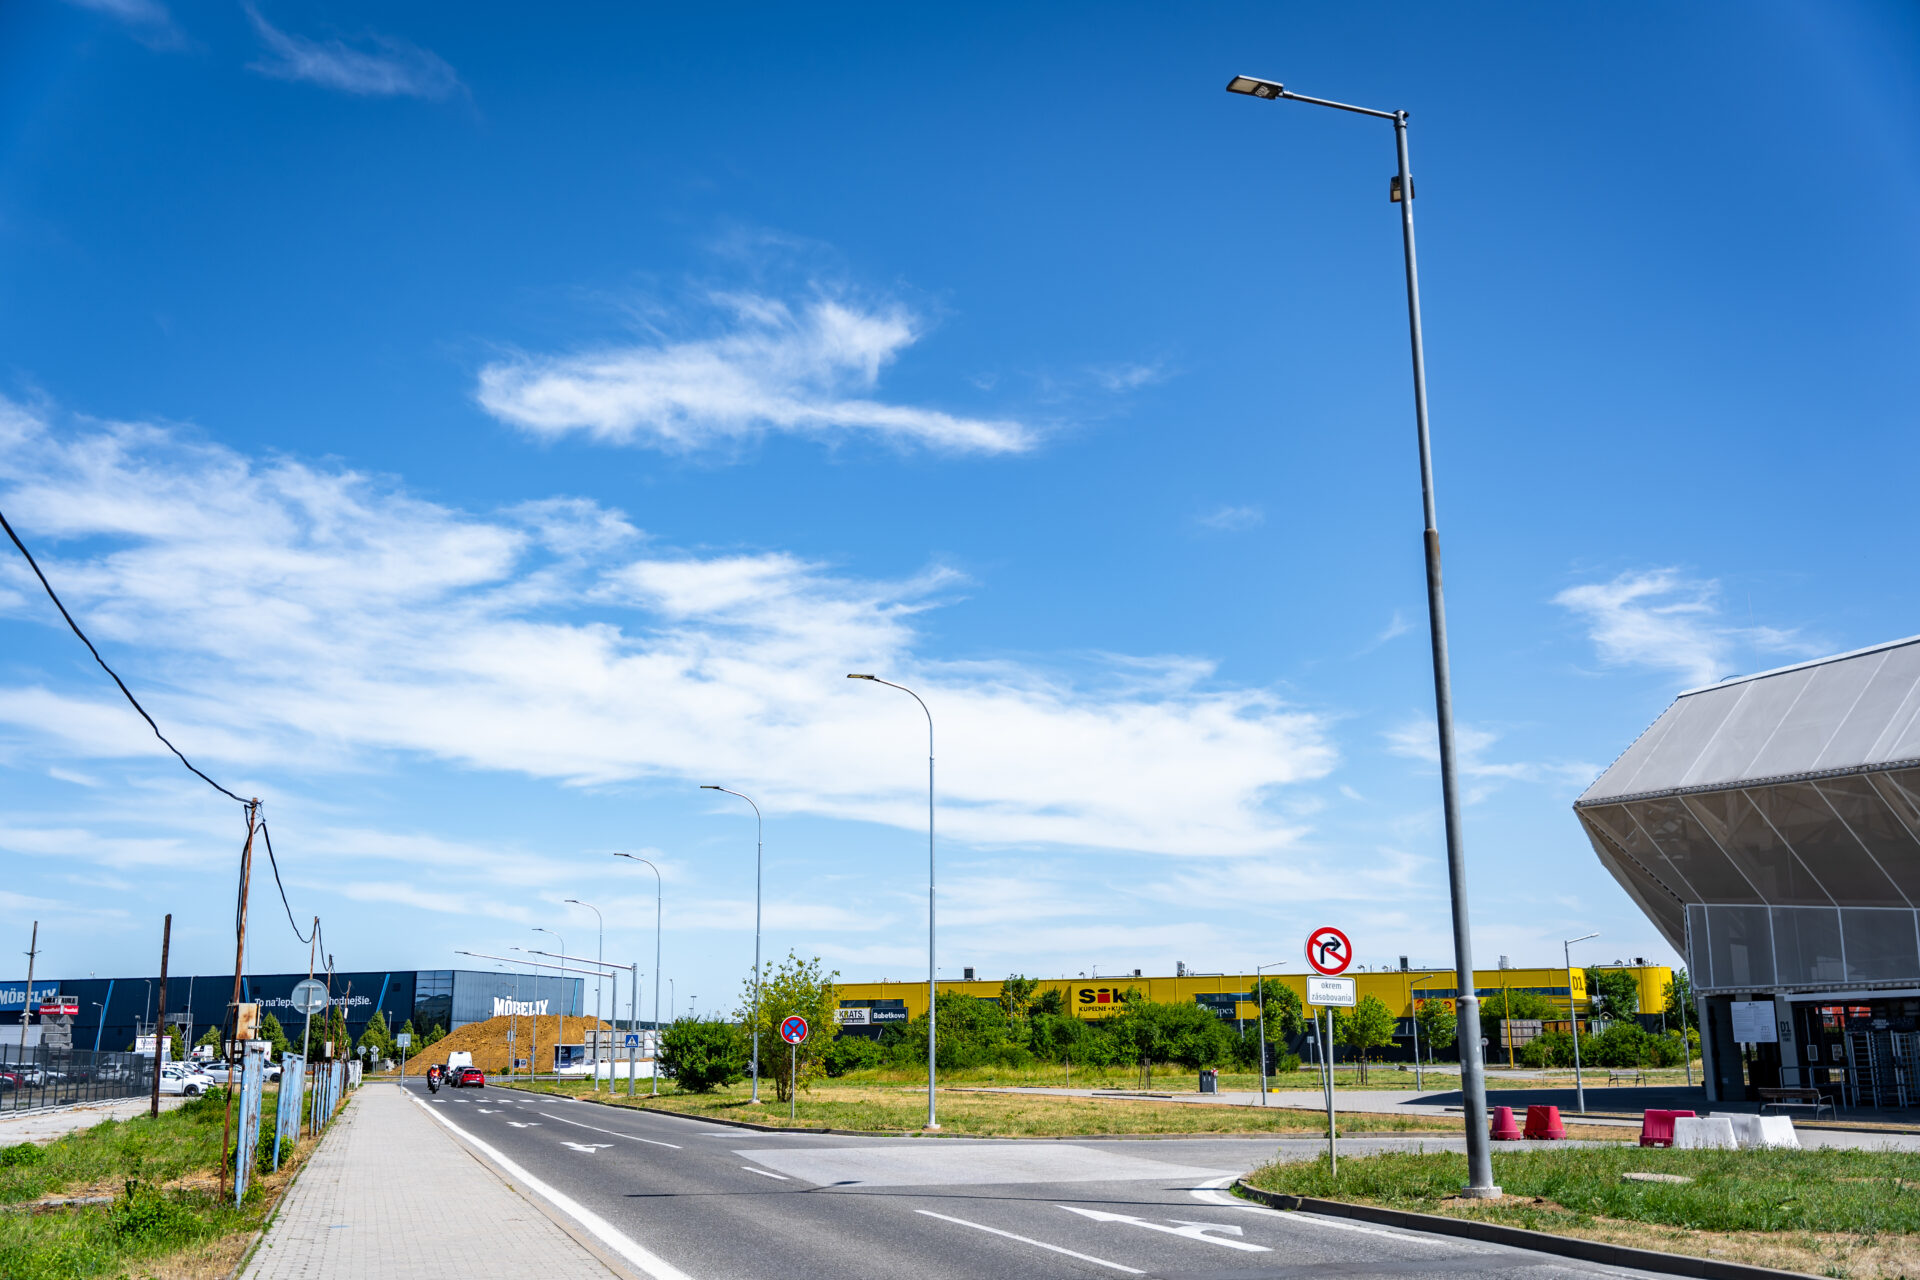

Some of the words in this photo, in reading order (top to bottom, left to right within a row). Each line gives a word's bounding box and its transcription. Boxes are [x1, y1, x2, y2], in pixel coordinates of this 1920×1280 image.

[1572, 976, 1584, 991] D1
[1312, 993, 1352, 1002] zásobovania
[1780, 1021, 1792, 1032] D1
